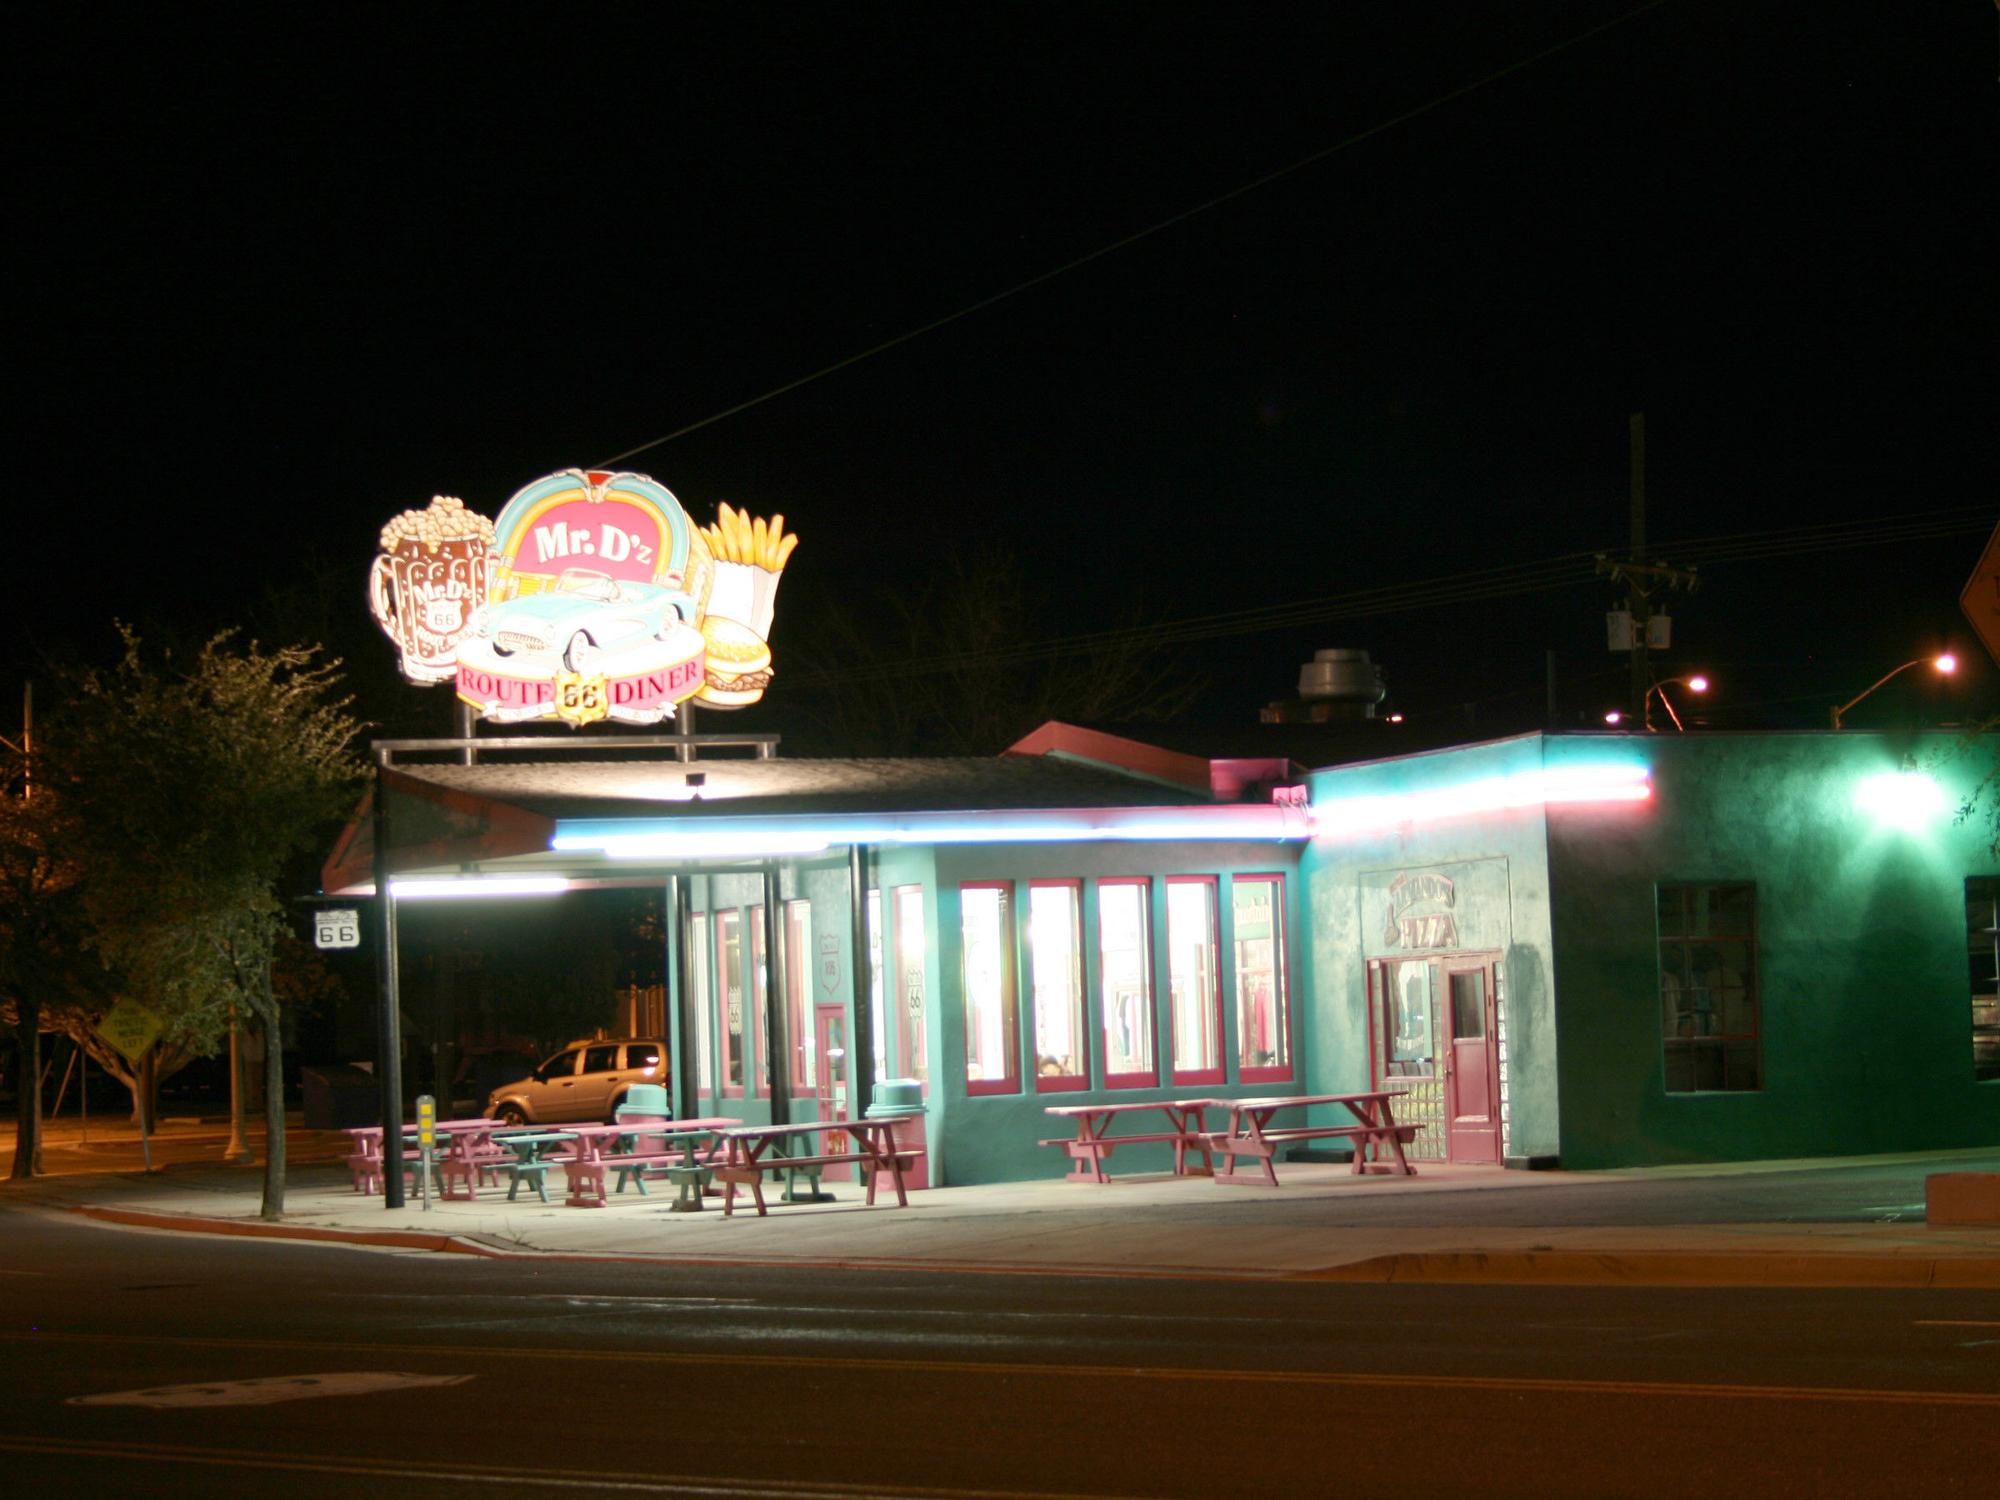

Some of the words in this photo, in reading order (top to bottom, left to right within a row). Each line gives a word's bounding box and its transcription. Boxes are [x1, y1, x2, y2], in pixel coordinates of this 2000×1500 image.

[534, 522, 596, 563] Mr.
[598, 523, 653, 565] D'z
[434, 613, 455, 626] 66
[461, 667, 552, 704] ROUTE
[563, 683, 599, 709] 66
[614, 661, 697, 705] DINER
[319, 925, 354, 943] 66
[910, 987, 921, 1009] 66
